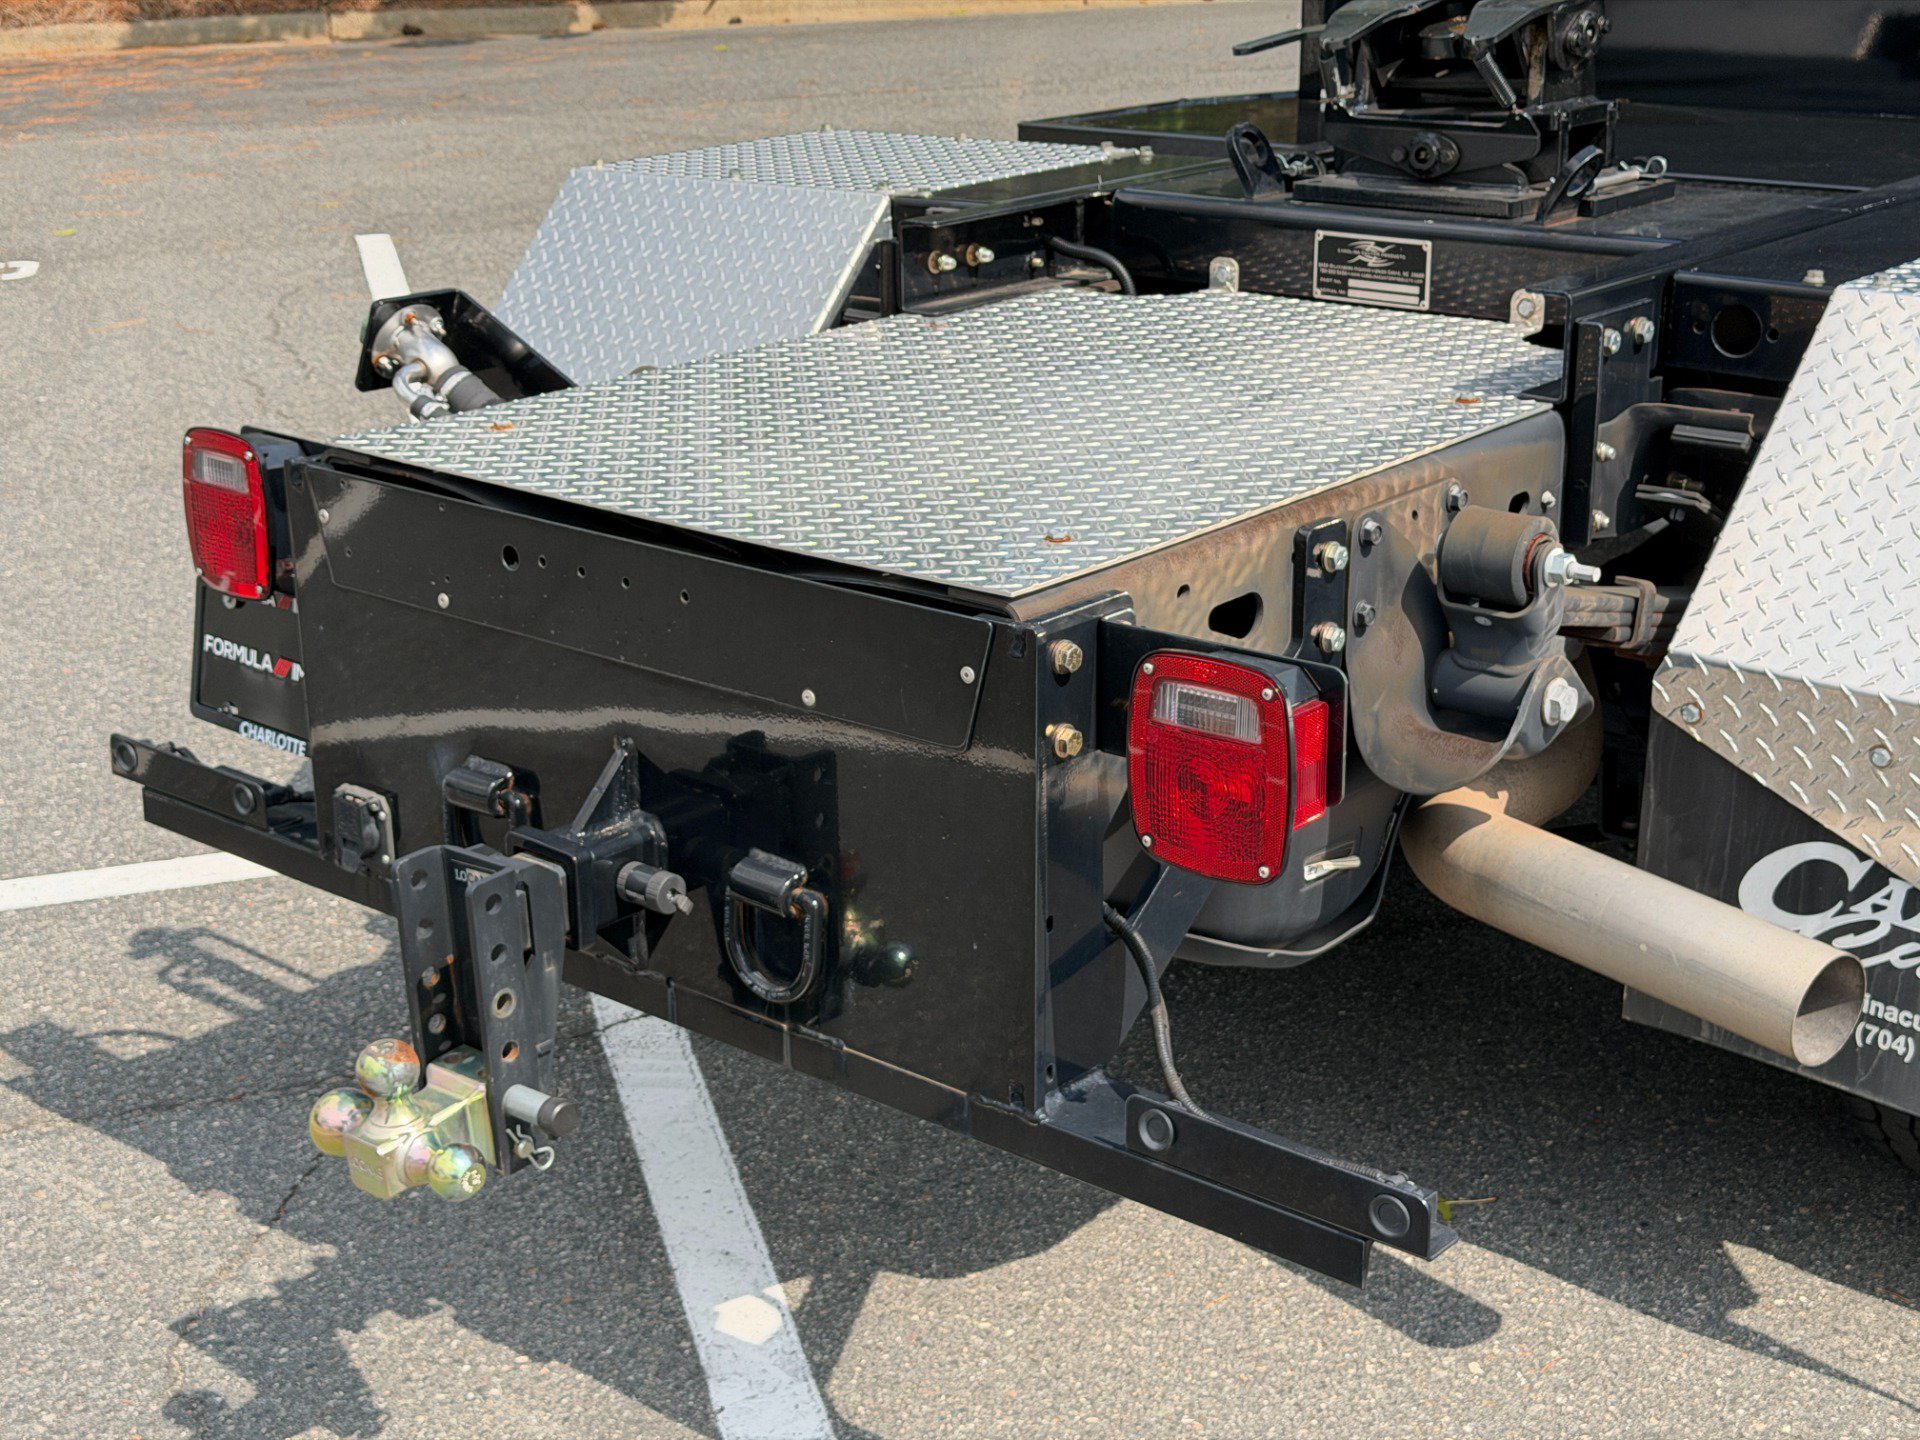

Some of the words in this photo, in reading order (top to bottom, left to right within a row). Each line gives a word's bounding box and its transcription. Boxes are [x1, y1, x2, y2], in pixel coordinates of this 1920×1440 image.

[203, 633, 274, 673] FORMULA
[239, 720, 307, 757] CHARLOTTE
[1855, 1020, 1915, 1063] (704)
